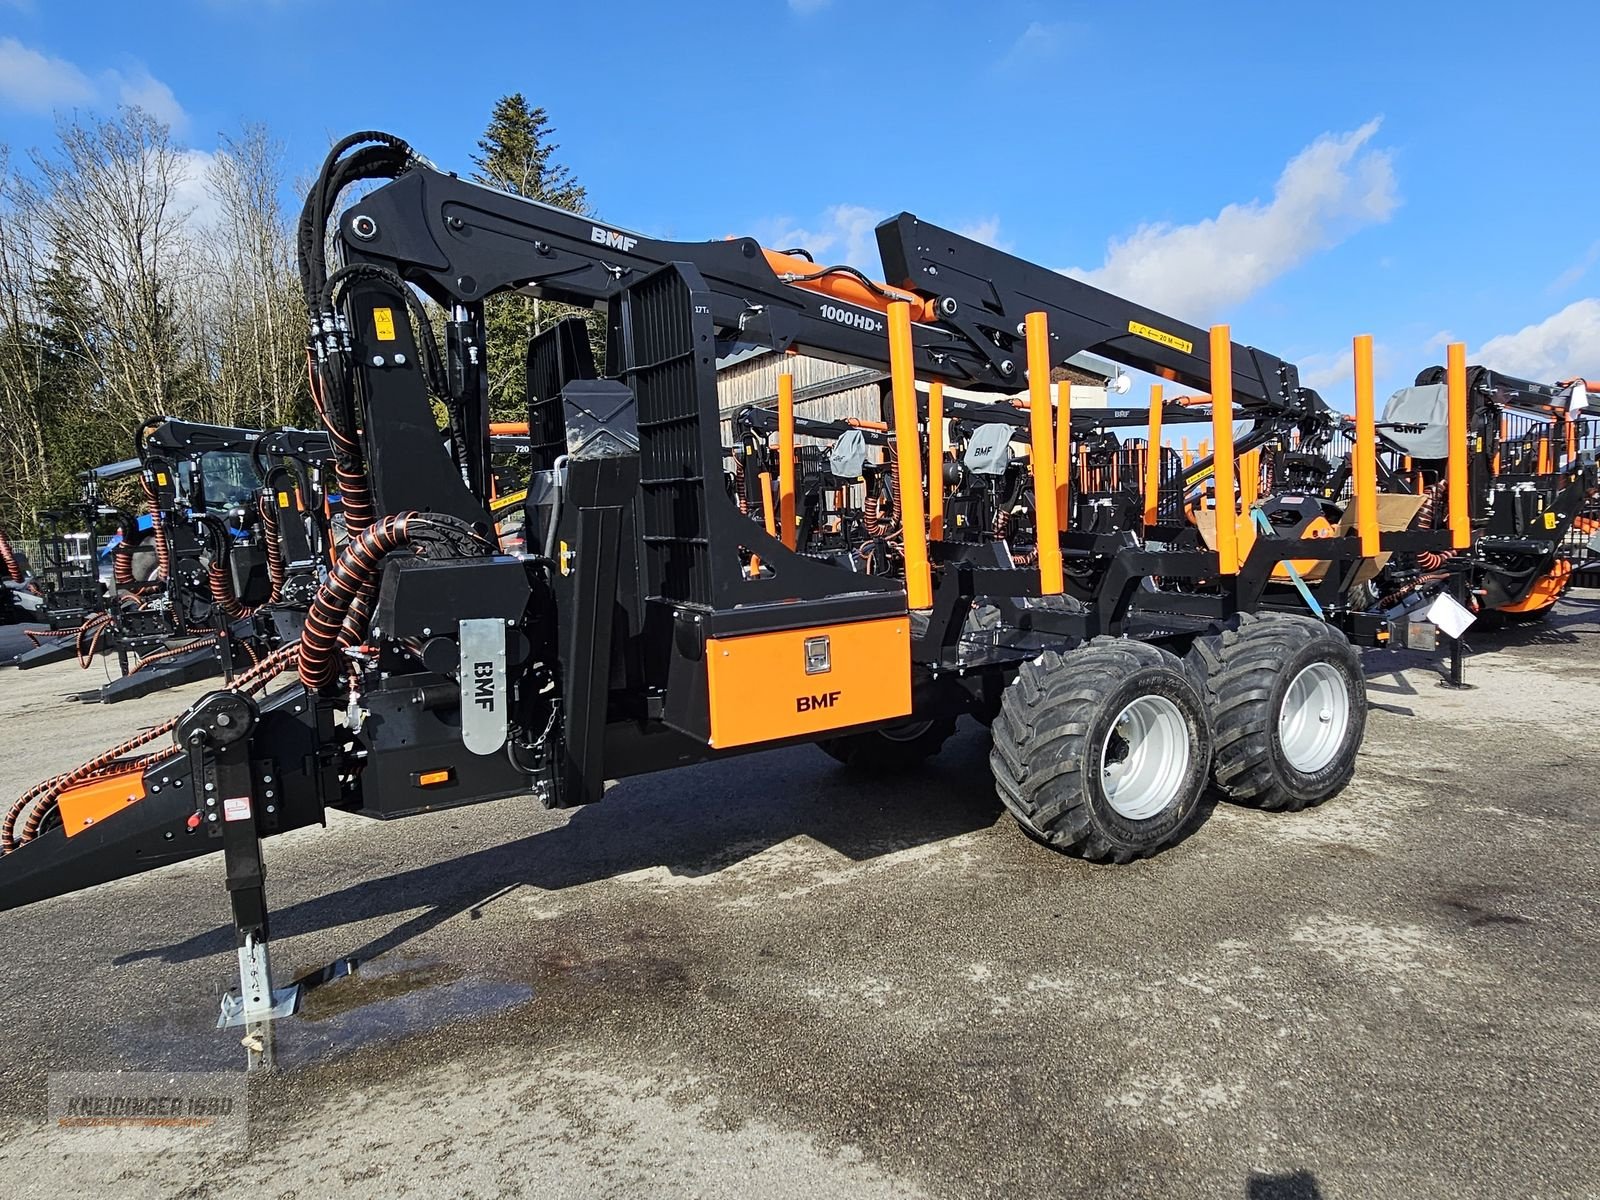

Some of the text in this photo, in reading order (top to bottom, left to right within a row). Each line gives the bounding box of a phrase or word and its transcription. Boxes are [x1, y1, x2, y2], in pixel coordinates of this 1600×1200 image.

[591, 226, 638, 252] BMF
[819, 304, 884, 332] 1000HD+
[1159, 334, 1168, 342] 20
[514, 445, 530, 453] 720
[974, 446, 993, 457] BMF
[473, 661, 495, 713] BMF
[796, 690, 842, 713] BMF
